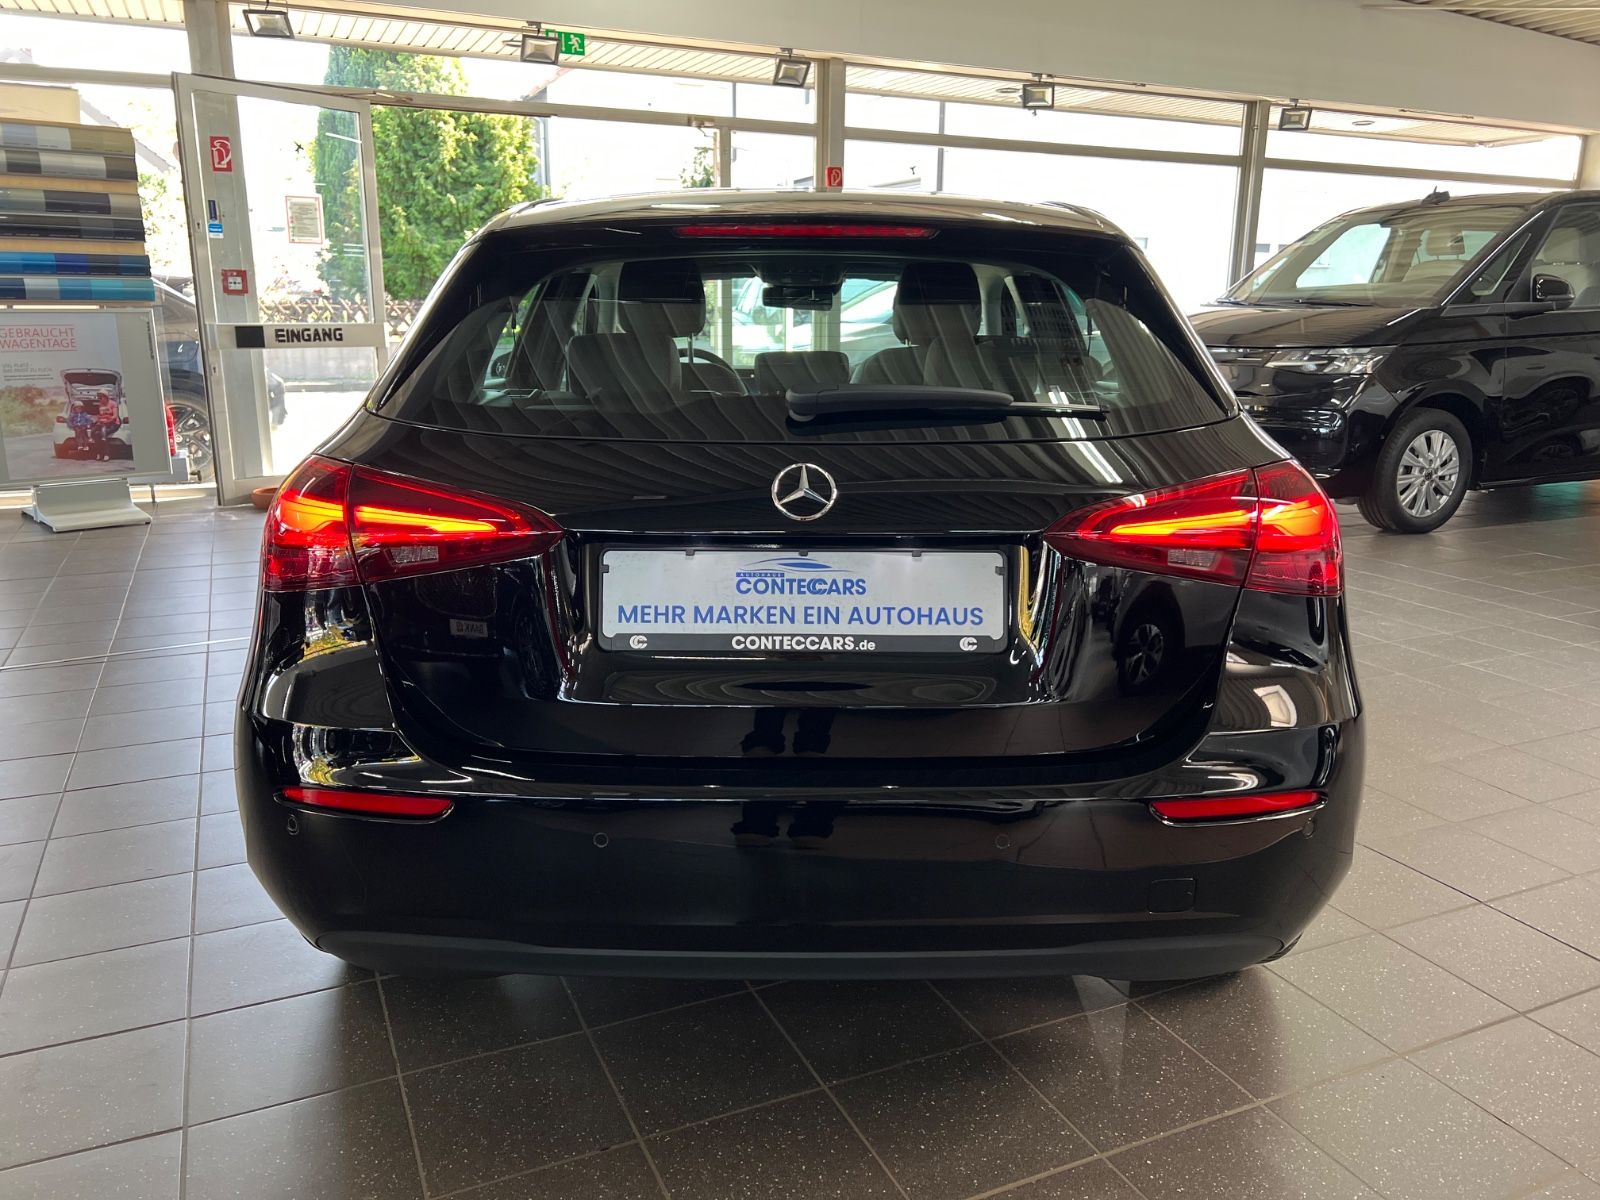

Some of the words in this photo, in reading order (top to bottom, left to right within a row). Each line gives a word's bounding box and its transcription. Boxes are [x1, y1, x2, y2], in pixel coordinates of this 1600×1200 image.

[0, 327, 75, 338] GEBRAUCHT
[274, 327, 343, 343] EINGANG
[0, 338, 77, 349] WAGENTAGE
[617, 605, 686, 624] MEHR
[693, 605, 796, 625] MARKEN
[803, 606, 840, 625] EIN
[847, 606, 984, 626] AUTOHAUS
[731, 635, 876, 651] CONTECCARS.de
